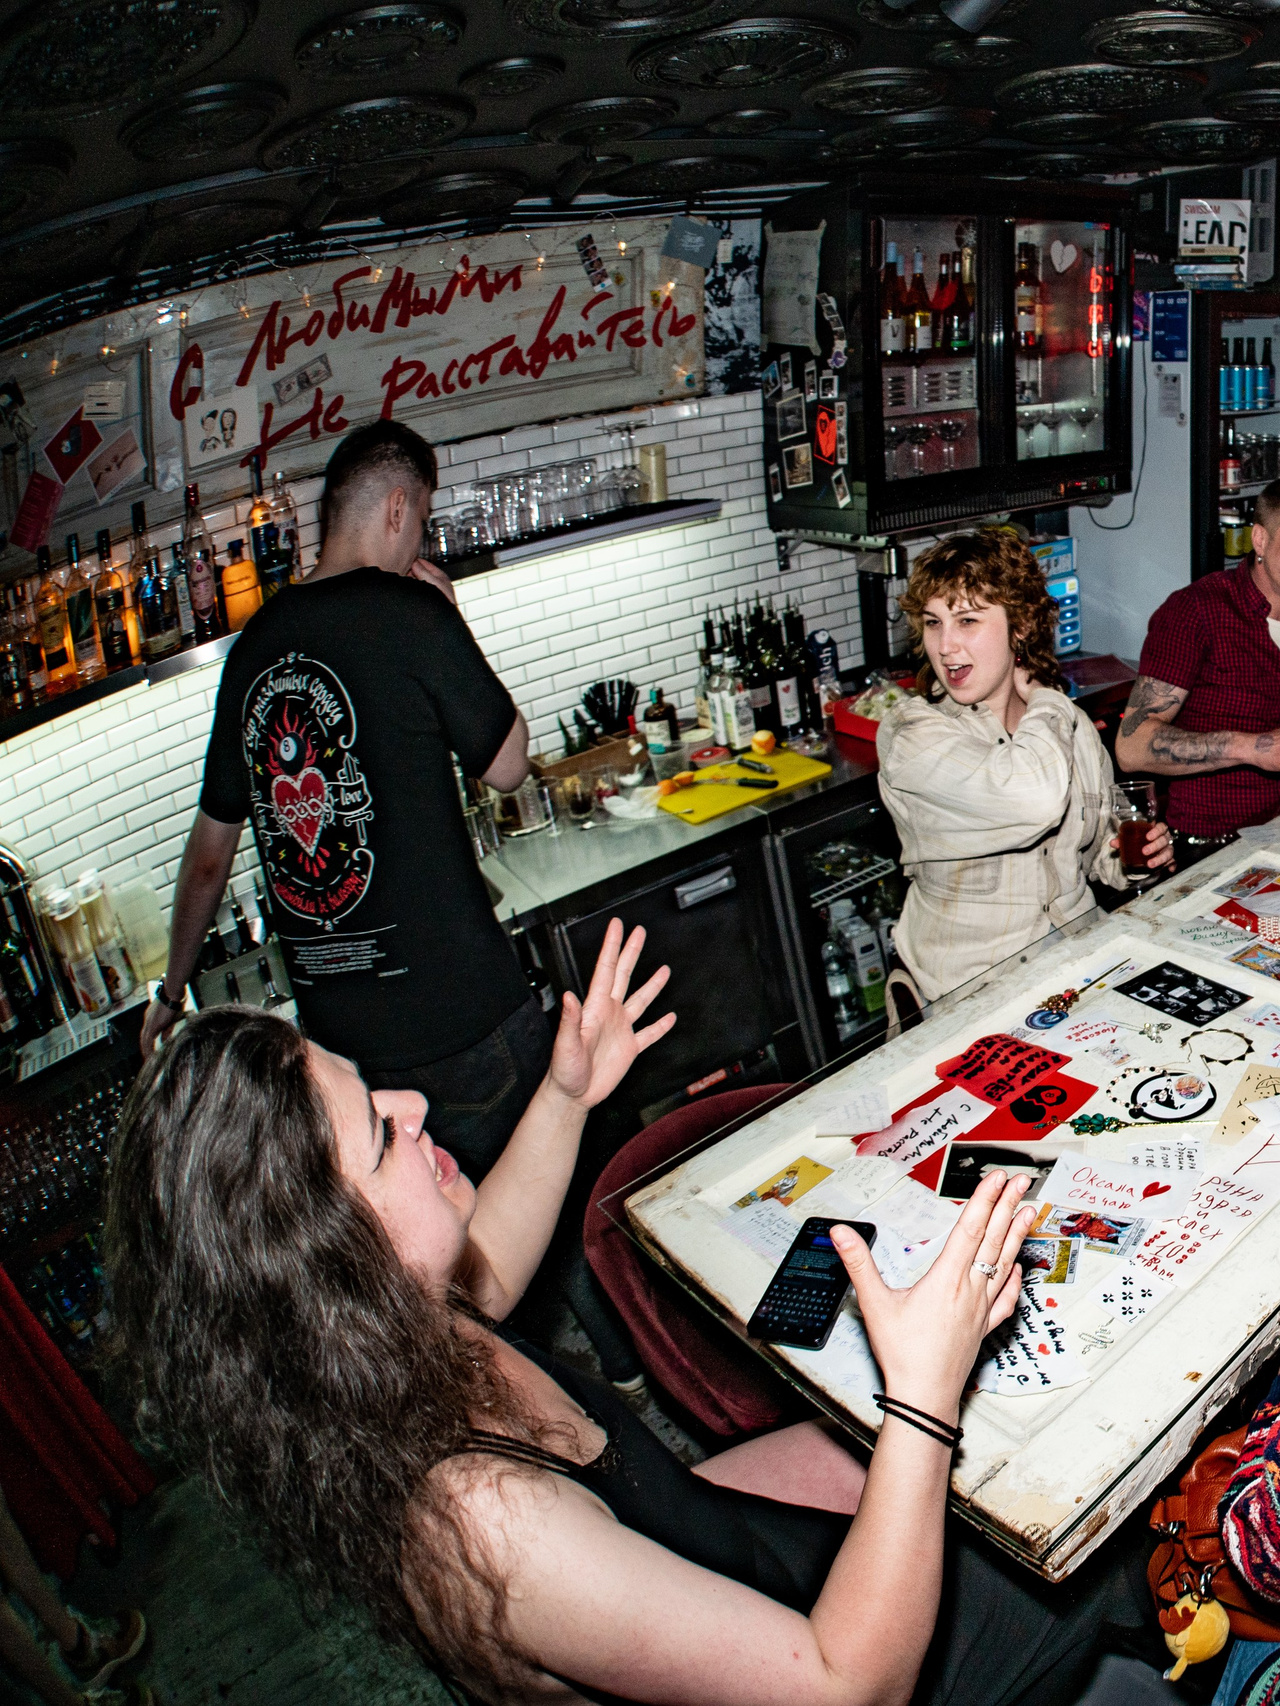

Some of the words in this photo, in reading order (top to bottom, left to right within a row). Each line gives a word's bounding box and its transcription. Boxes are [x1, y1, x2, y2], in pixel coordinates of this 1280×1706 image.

[240, 387, 351, 471] Не
[381, 285, 697, 420] Расставайтесь
[283, 740, 290, 752] 8
[1072, 1166, 1135, 1198] Оксана
[1150, 1240, 1185, 1259] 10
